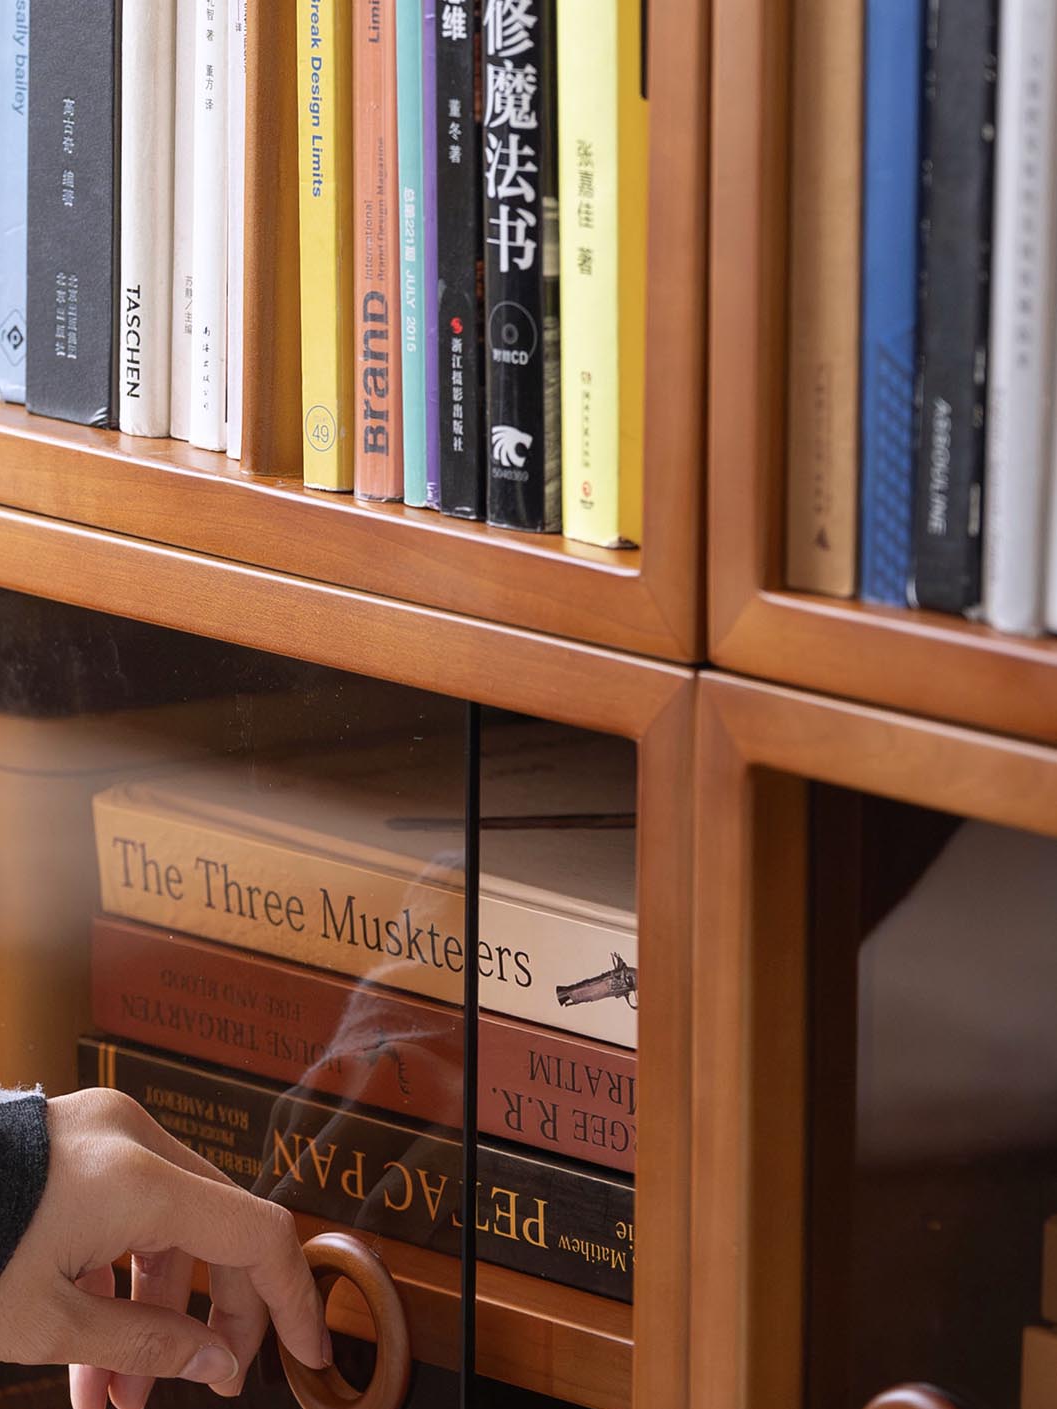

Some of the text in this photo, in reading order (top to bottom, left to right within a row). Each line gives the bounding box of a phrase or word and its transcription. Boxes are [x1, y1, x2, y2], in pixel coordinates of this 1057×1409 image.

[12, 0, 28, 117] sally bailey
[441, 0, 468, 41] 维
[309, 0, 323, 198] reak Design Limits
[483, 0, 539, 274] 修魔法书
[363, 199, 374, 281] International
[405, 269, 416, 308] JULY
[125, 284, 142, 399] TASCHEN
[312, 424, 330, 443] 49
[450, 337, 464, 452] 浙江摄影出版社
[112, 837, 184, 901] The
[194, 857, 306, 932] Three
[491, 1087, 637, 1152] GEE R.R.
